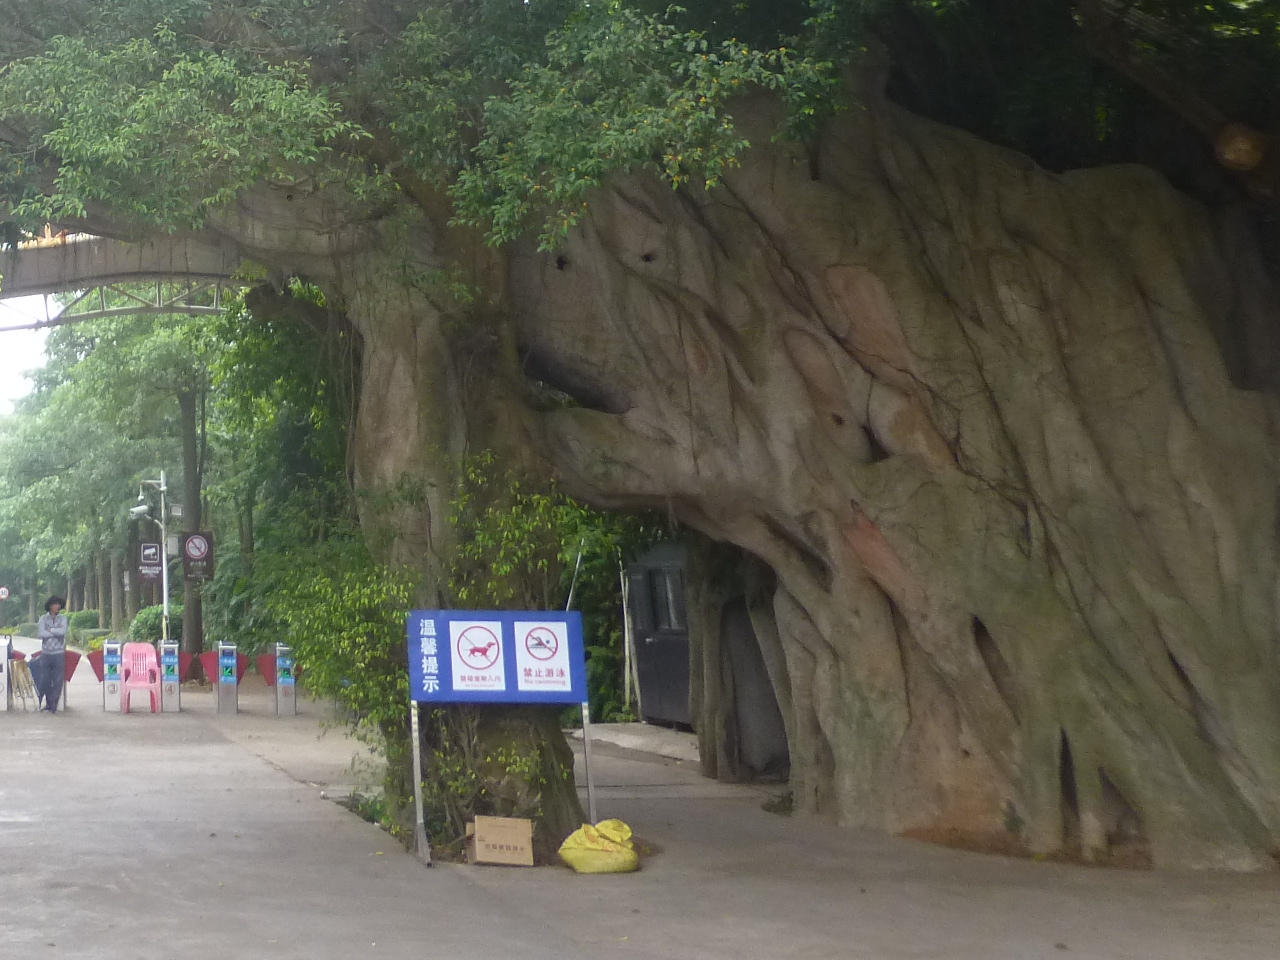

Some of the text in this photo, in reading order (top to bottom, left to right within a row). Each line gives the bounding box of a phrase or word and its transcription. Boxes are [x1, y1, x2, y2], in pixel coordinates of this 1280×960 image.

[420, 619, 439, 693] 温馨提示
[524, 667, 566, 677] 禁止游泳
